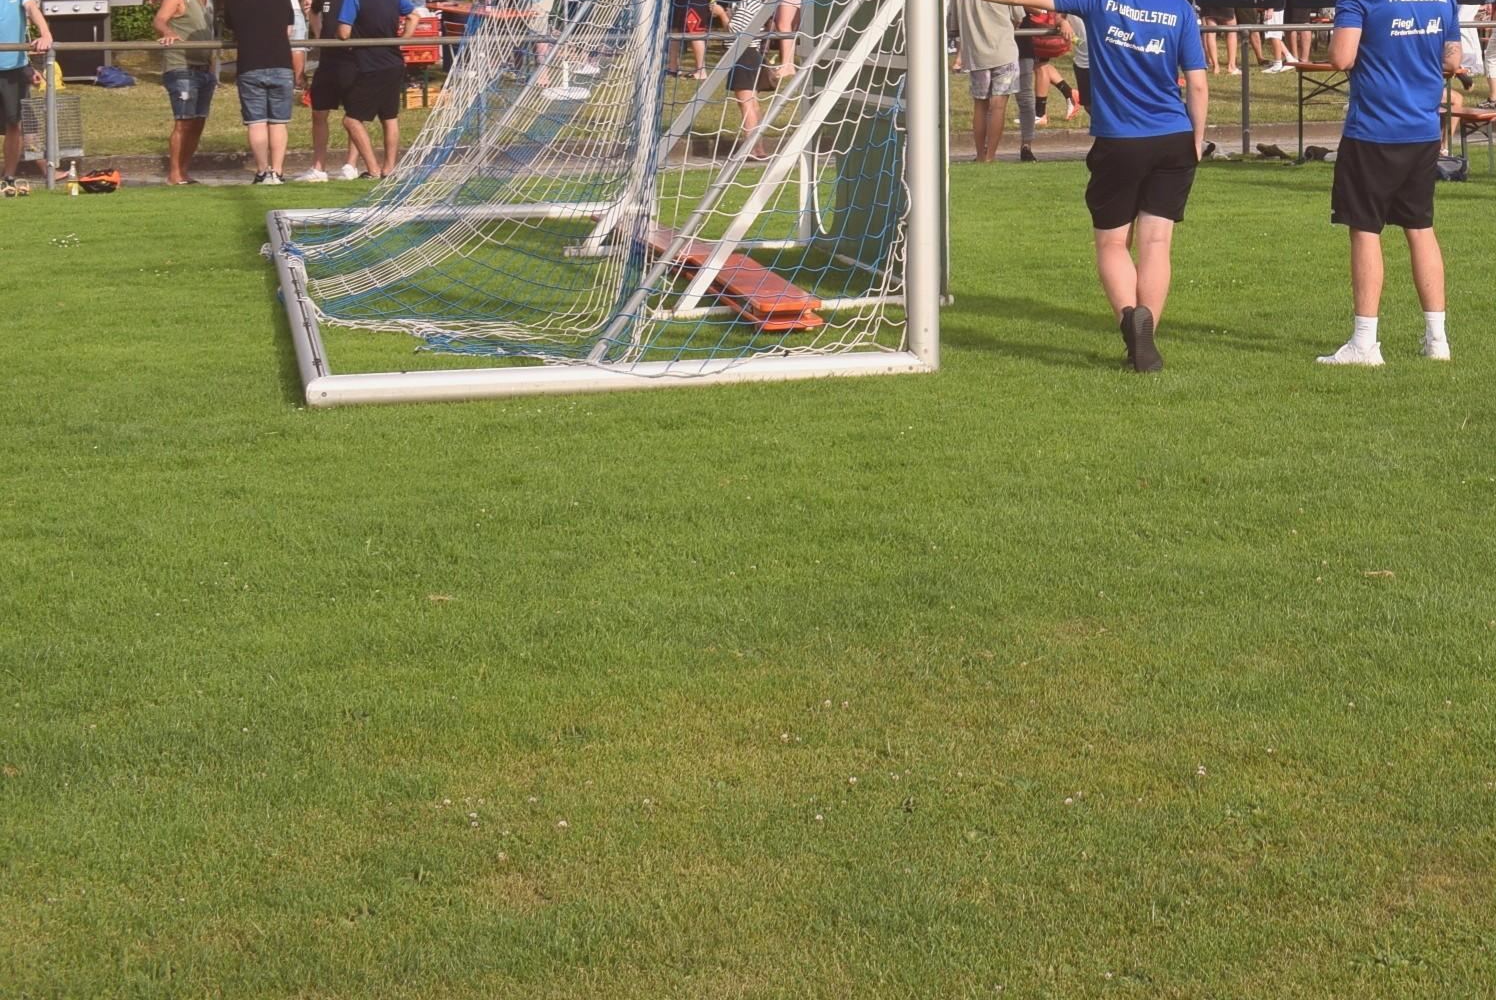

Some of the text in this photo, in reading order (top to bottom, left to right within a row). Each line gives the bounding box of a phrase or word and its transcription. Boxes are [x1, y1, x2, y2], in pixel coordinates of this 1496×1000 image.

[1106, 0, 1178, 27] FV WENDELSTEIN
[1391, 17, 1414, 30] Fiegl
[1107, 25, 1135, 41] Fiegl
